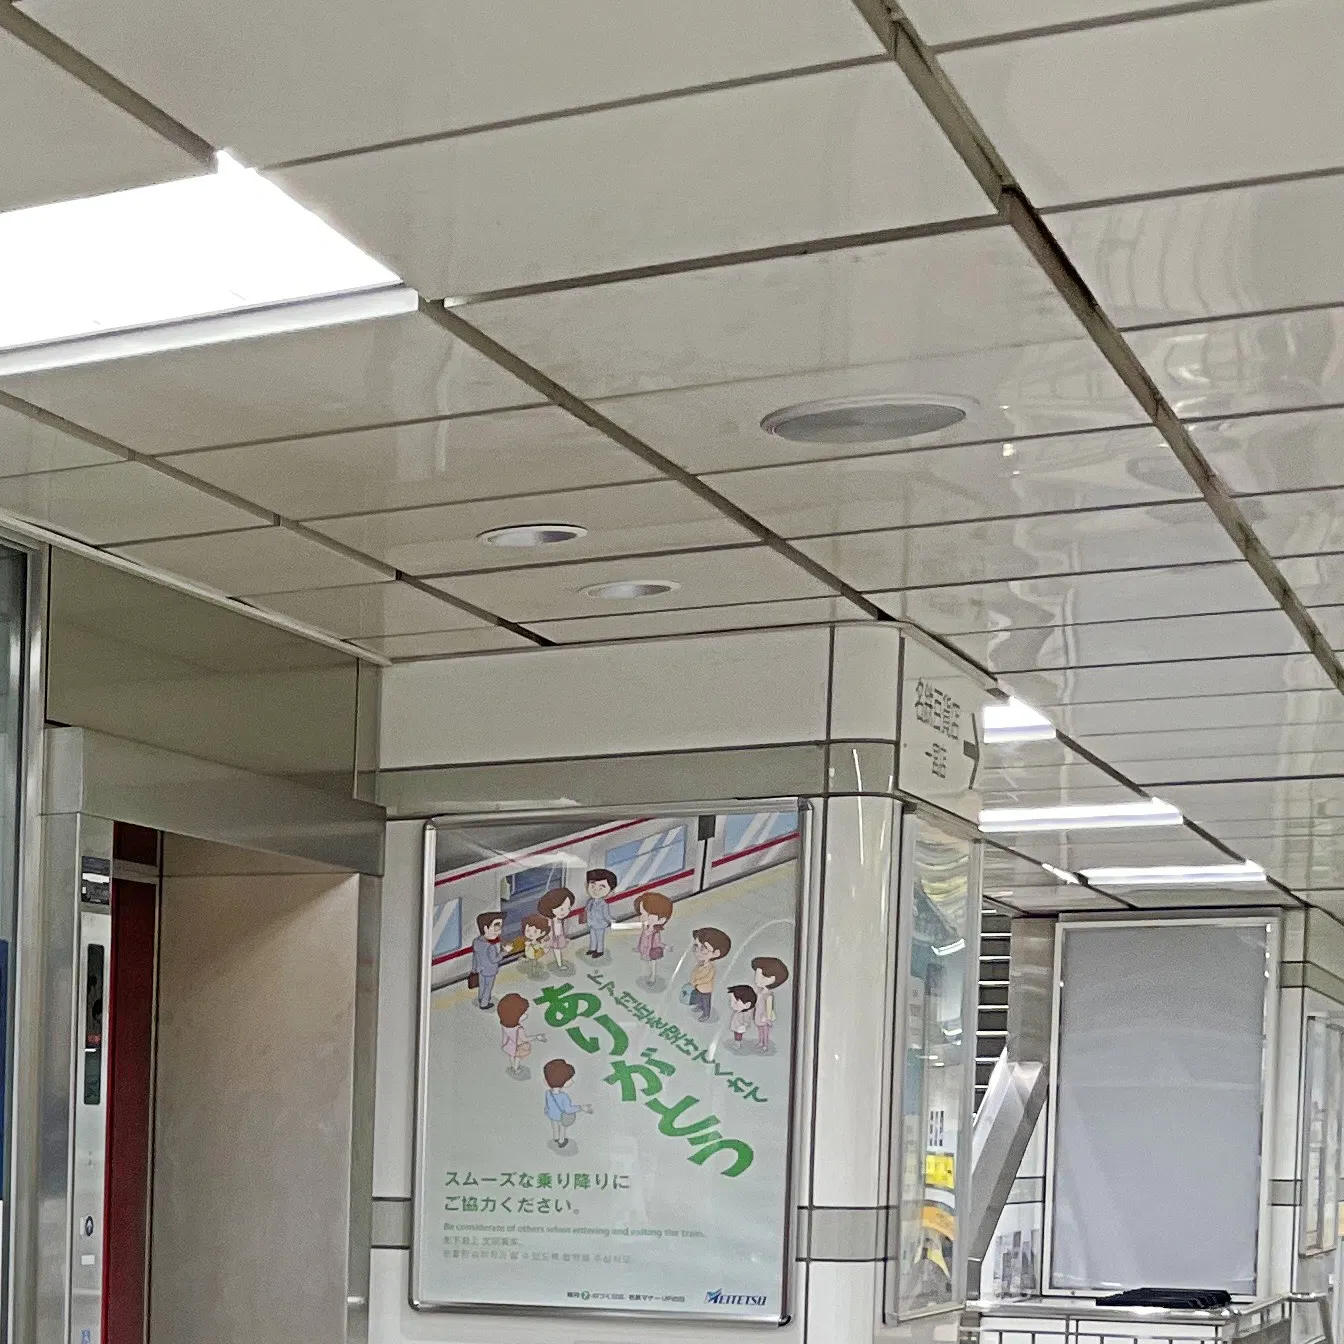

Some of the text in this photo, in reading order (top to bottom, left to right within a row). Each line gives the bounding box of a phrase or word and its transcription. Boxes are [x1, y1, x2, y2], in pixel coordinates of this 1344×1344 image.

[533, 982, 755, 1178] ありがとう
[444, 1170, 630, 1191] スムーズな乗り降りに
[444, 1196, 581, 1215] ご協力ください。
[705, 1287, 768, 1307] MEITETSU
